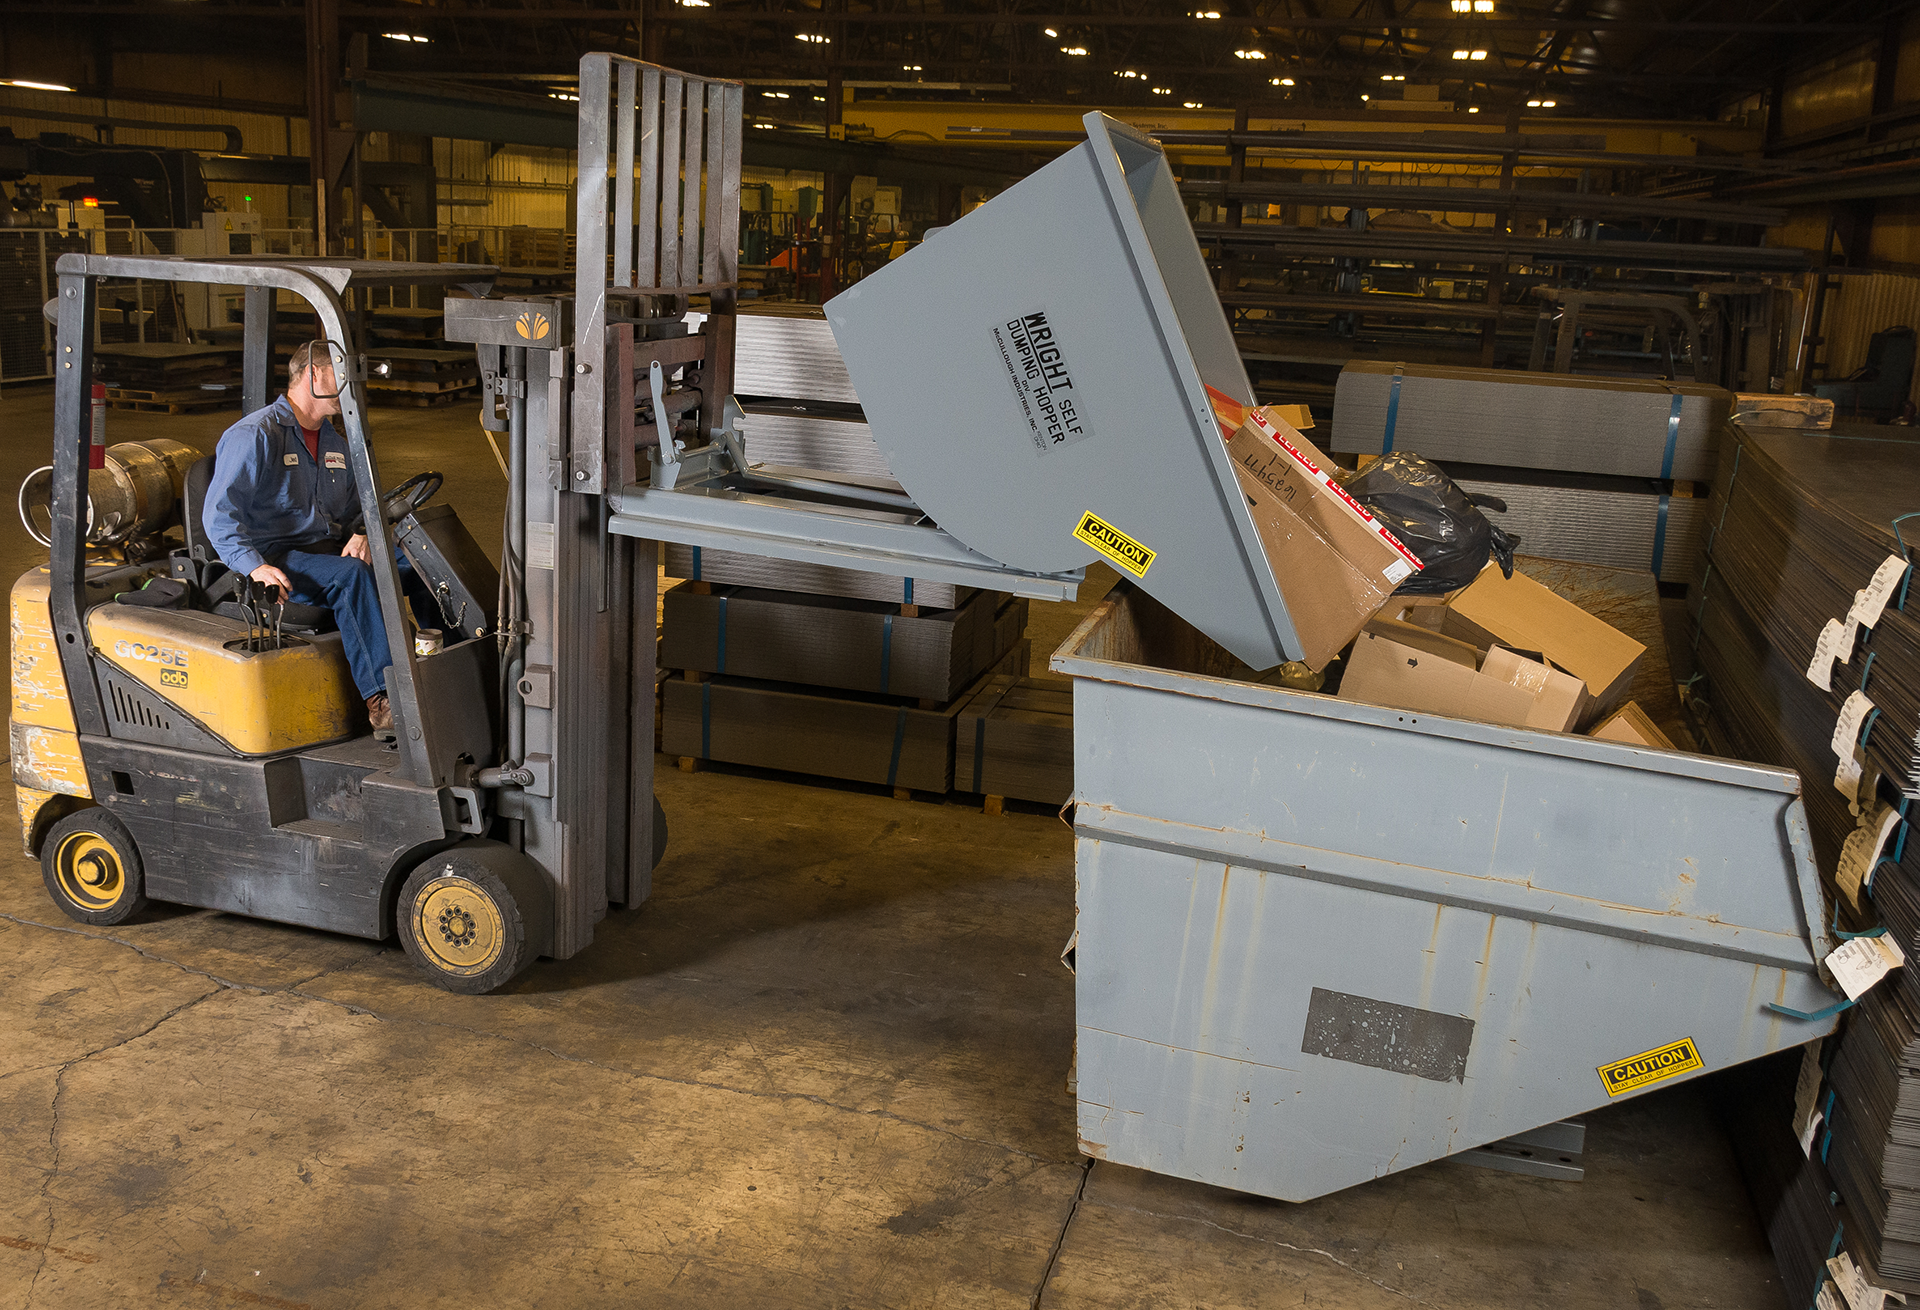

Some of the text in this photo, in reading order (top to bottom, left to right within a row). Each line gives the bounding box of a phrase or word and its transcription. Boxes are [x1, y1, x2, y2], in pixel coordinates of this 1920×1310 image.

[992, 327, 1038, 433] McCULLOUGH INDUSTRIES, INC.
[1006, 318, 1065, 445] DUMPING HOPPER
[1021, 380, 1031, 394] DIV.
[1024, 311, 1084, 434] WRIGHT SELF
[1080, 530, 1142, 571] STAY CLEAR OF HOPPER
[1088, 522, 1144, 563] CAUTION
[114, 639, 189, 668] GC25E
[161, 671, 187, 685] odb
[1613, 1048, 1686, 1081] CAUTION
[1613, 1082, 1629, 1090] STAY
[1631, 1074, 1653, 1084] CLEAR
[1668, 1060, 1695, 1072] HOPPER
